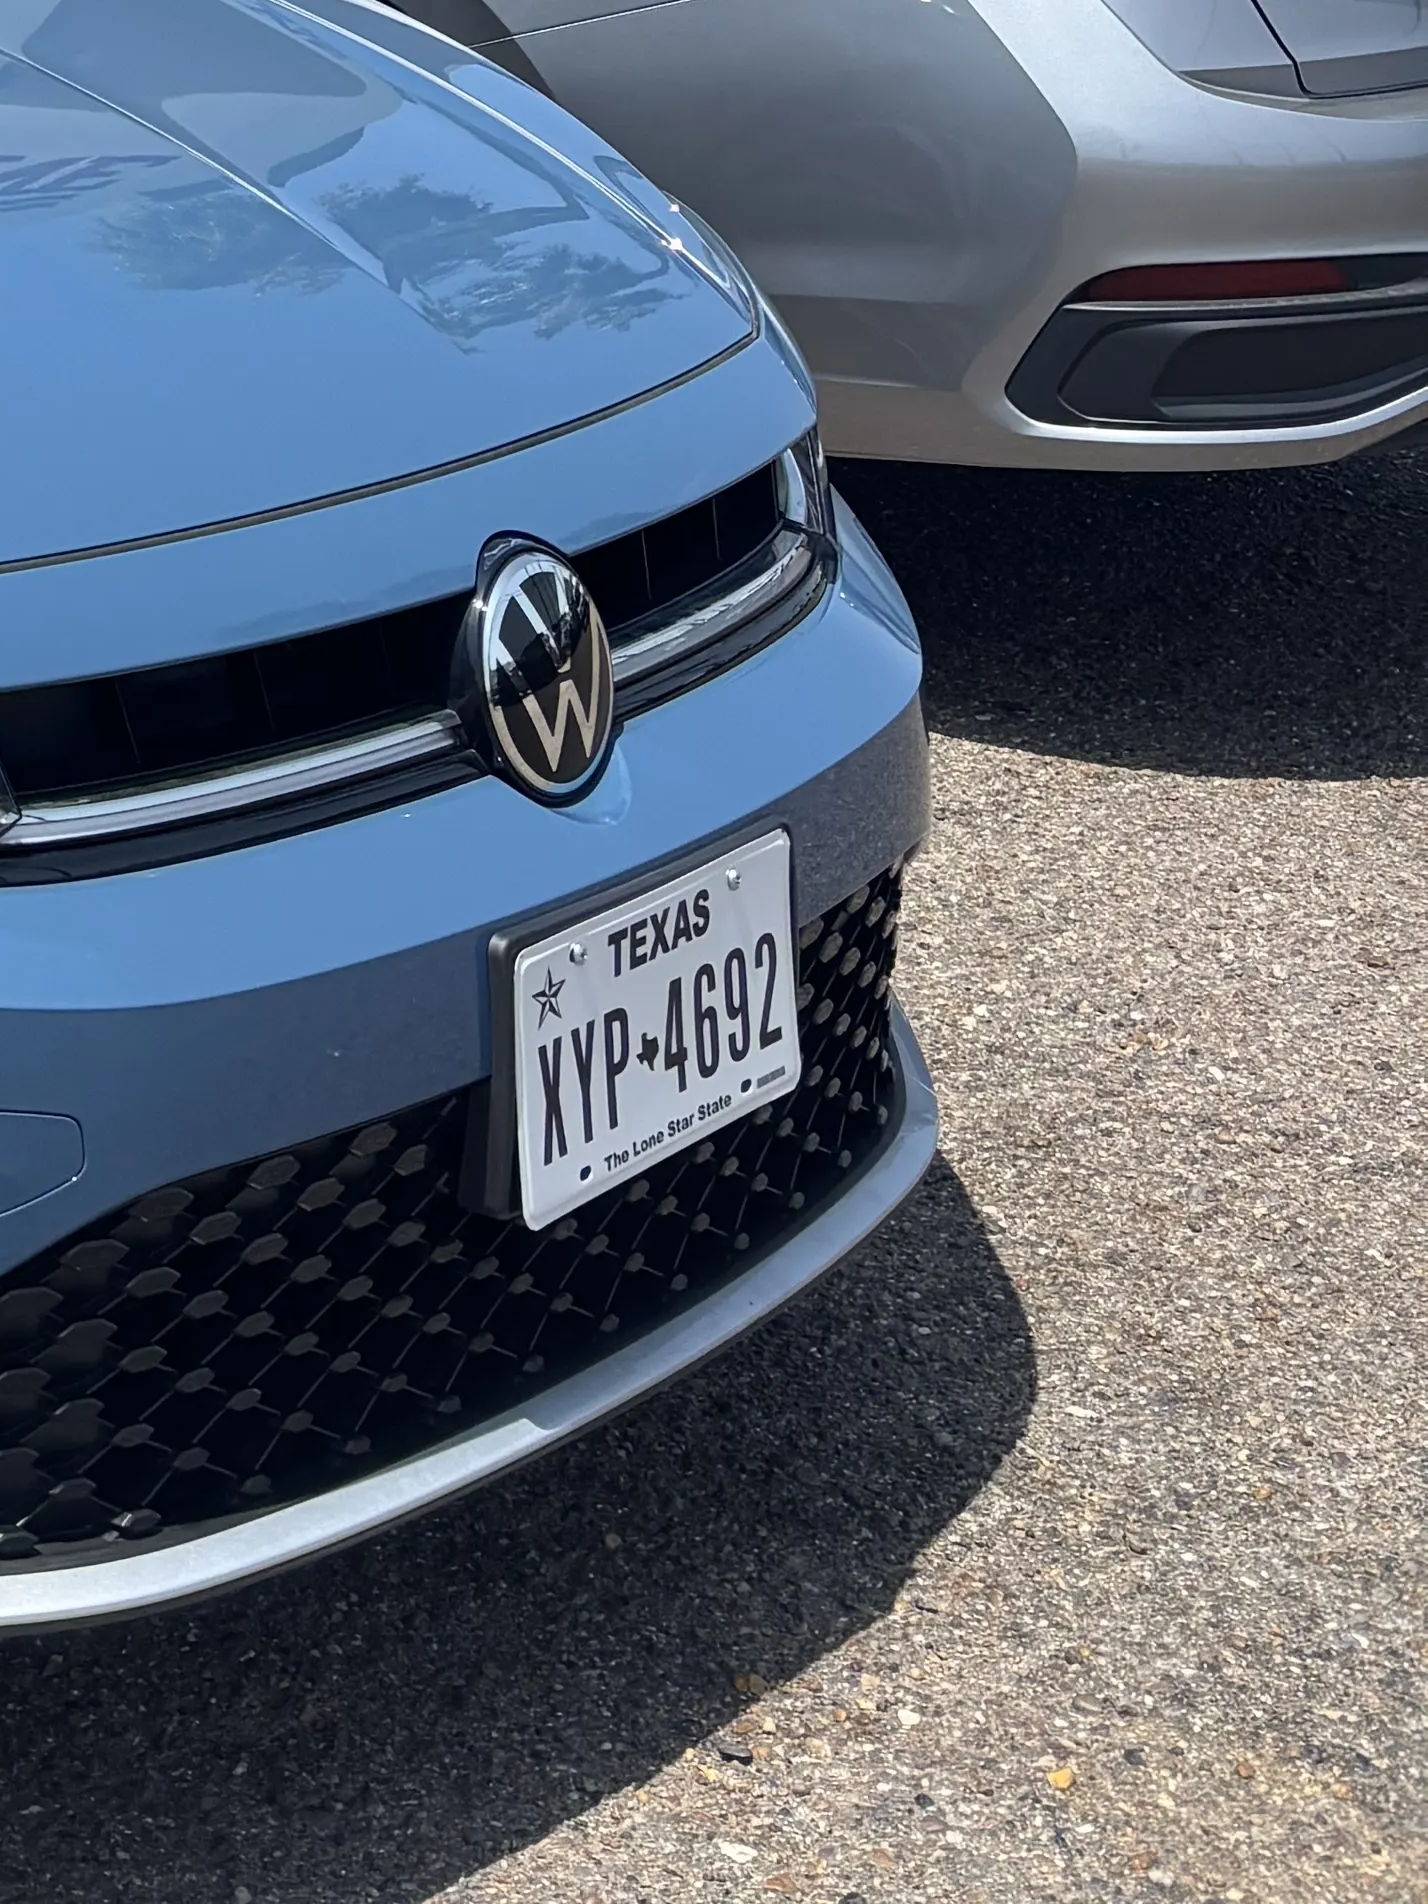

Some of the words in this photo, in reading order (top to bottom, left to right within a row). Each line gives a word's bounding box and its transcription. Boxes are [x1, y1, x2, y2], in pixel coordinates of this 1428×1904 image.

[608, 888, 711, 978] TEXAS
[604, 1151, 629, 1172] The
[632, 1130, 664, 1157] Lone
[667, 1113, 695, 1138] Star
[697, 1094, 732, 1121] State
